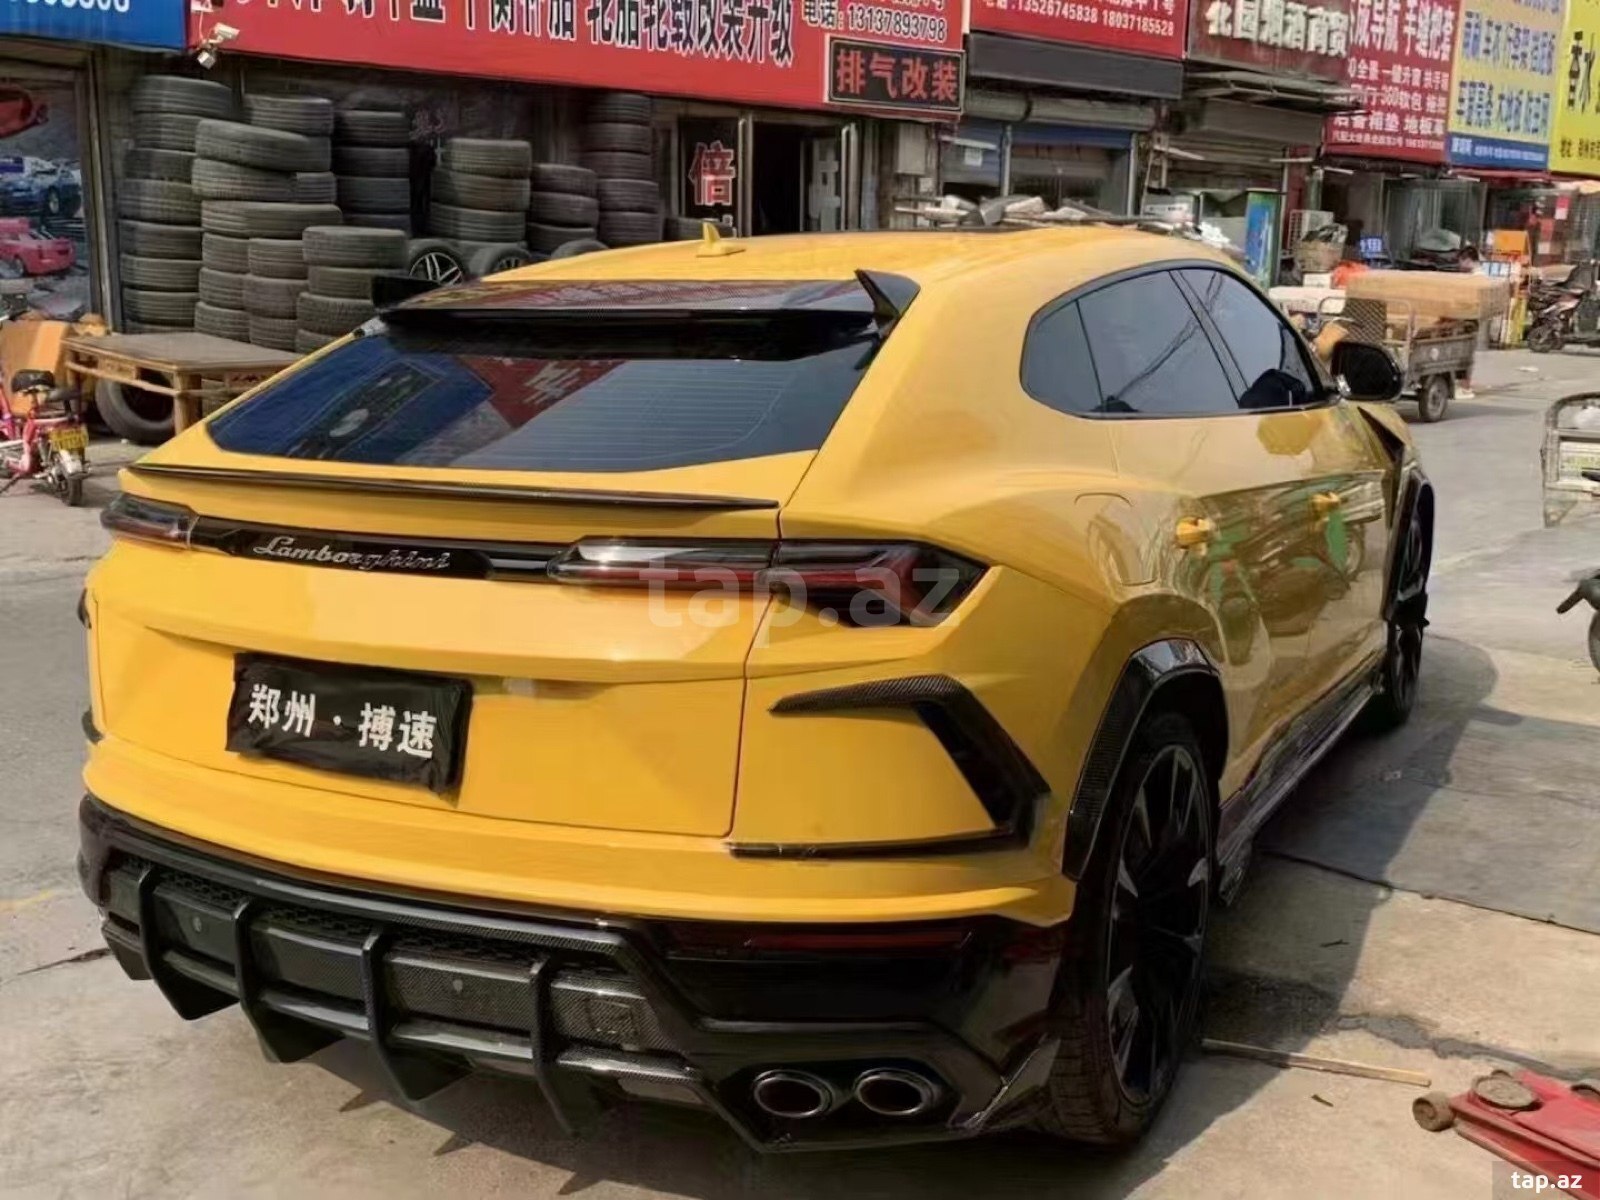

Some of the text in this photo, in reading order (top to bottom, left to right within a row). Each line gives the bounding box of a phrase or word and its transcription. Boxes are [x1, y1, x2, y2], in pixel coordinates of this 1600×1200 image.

[836, 48, 958, 101] 排气改装
[253, 536, 450, 571] Lamborghini
